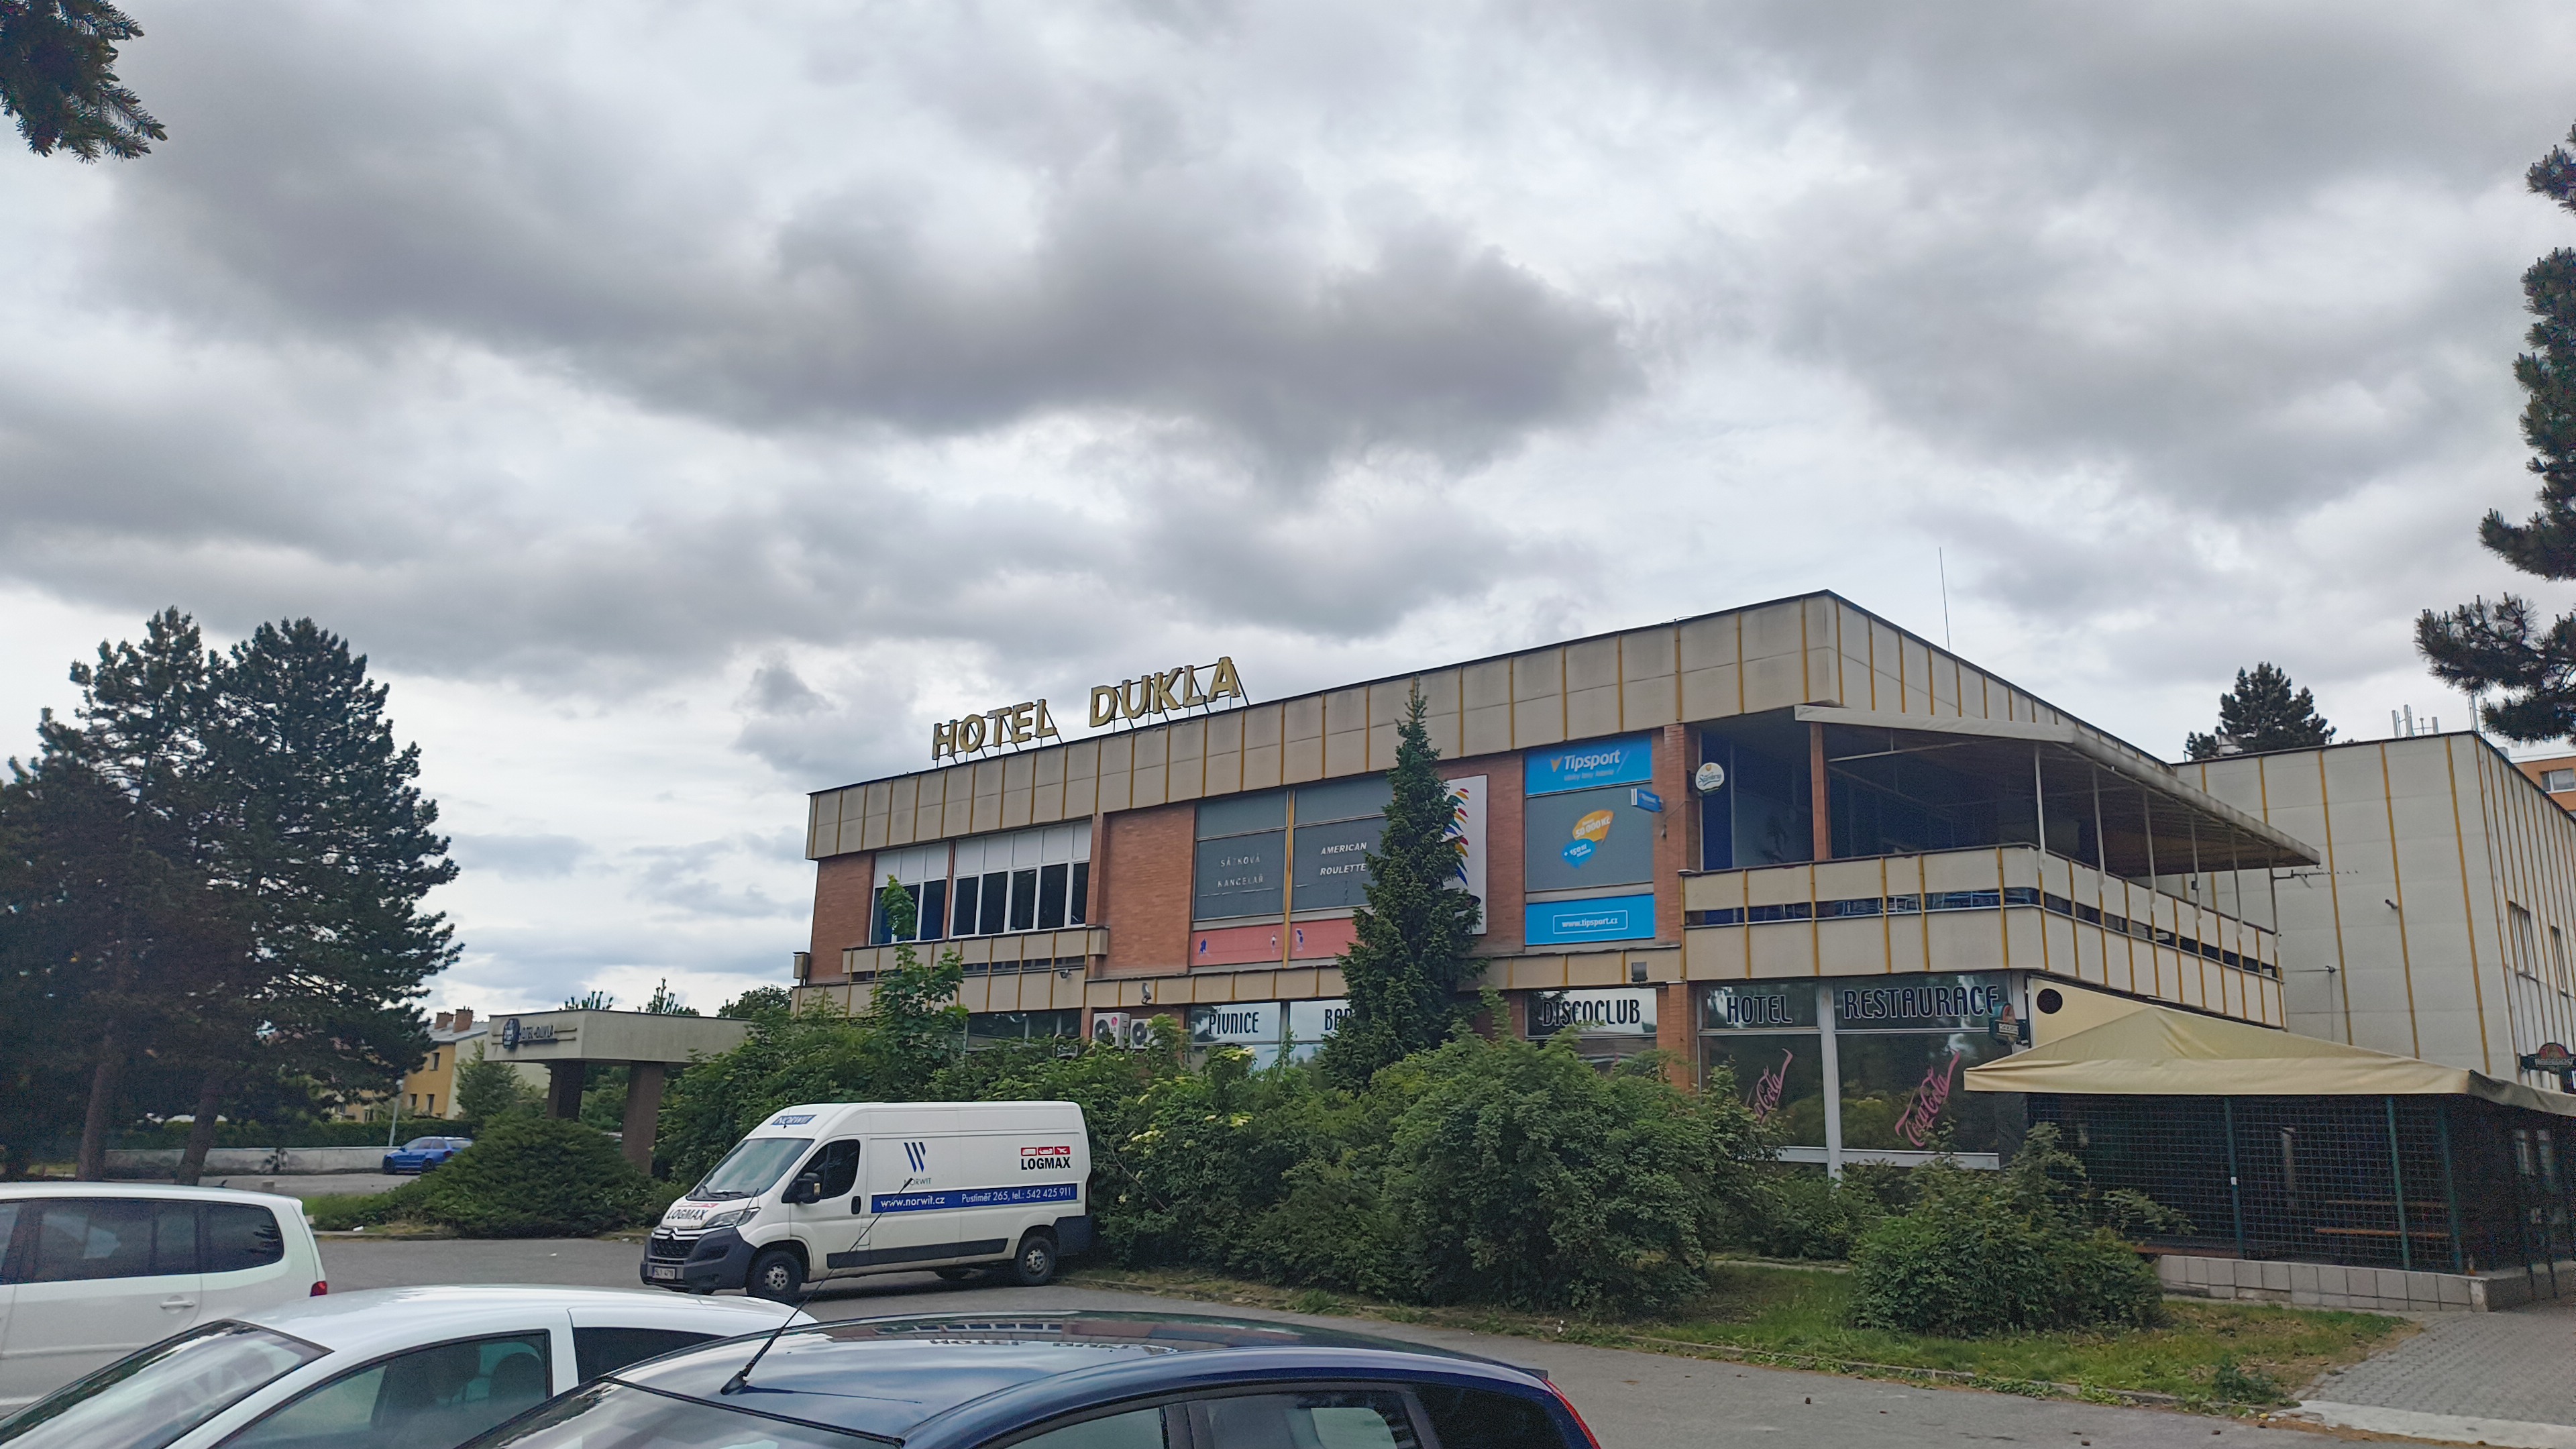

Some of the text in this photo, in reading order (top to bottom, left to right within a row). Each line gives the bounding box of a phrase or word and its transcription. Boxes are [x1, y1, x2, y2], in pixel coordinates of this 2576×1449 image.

[932, 656, 1241, 760] HOTEL DUKLA
[1564, 749, 1621, 771] Tipsport
[1320, 842, 1367, 855] AMERICAN
[1320, 863, 1366, 876] ROULETTE
[1562, 917, 1618, 928] www.tipsport.cz
[1726, 995, 1792, 1024] HOTEL
[1843, 984, 1999, 1020] RESTAURACE
[1208, 1012, 1259, 1034] PIVNICE
[1542, 999, 1641, 1027] DISCOCLUB
[1020, 1157, 1071, 1171] LOGMAX
[880, 1195, 945, 1208] www.norwit.cz
[993, 1191, 1010, 1202] 265,
[1012, 1189, 1024, 1199] tel.:
[1026, 1189, 1040, 1199] 542
[1042, 1187, 1057, 1197] 425
[1059, 1187, 1071, 1197] 911
[666, 1209, 708, 1221] LOGMAX
